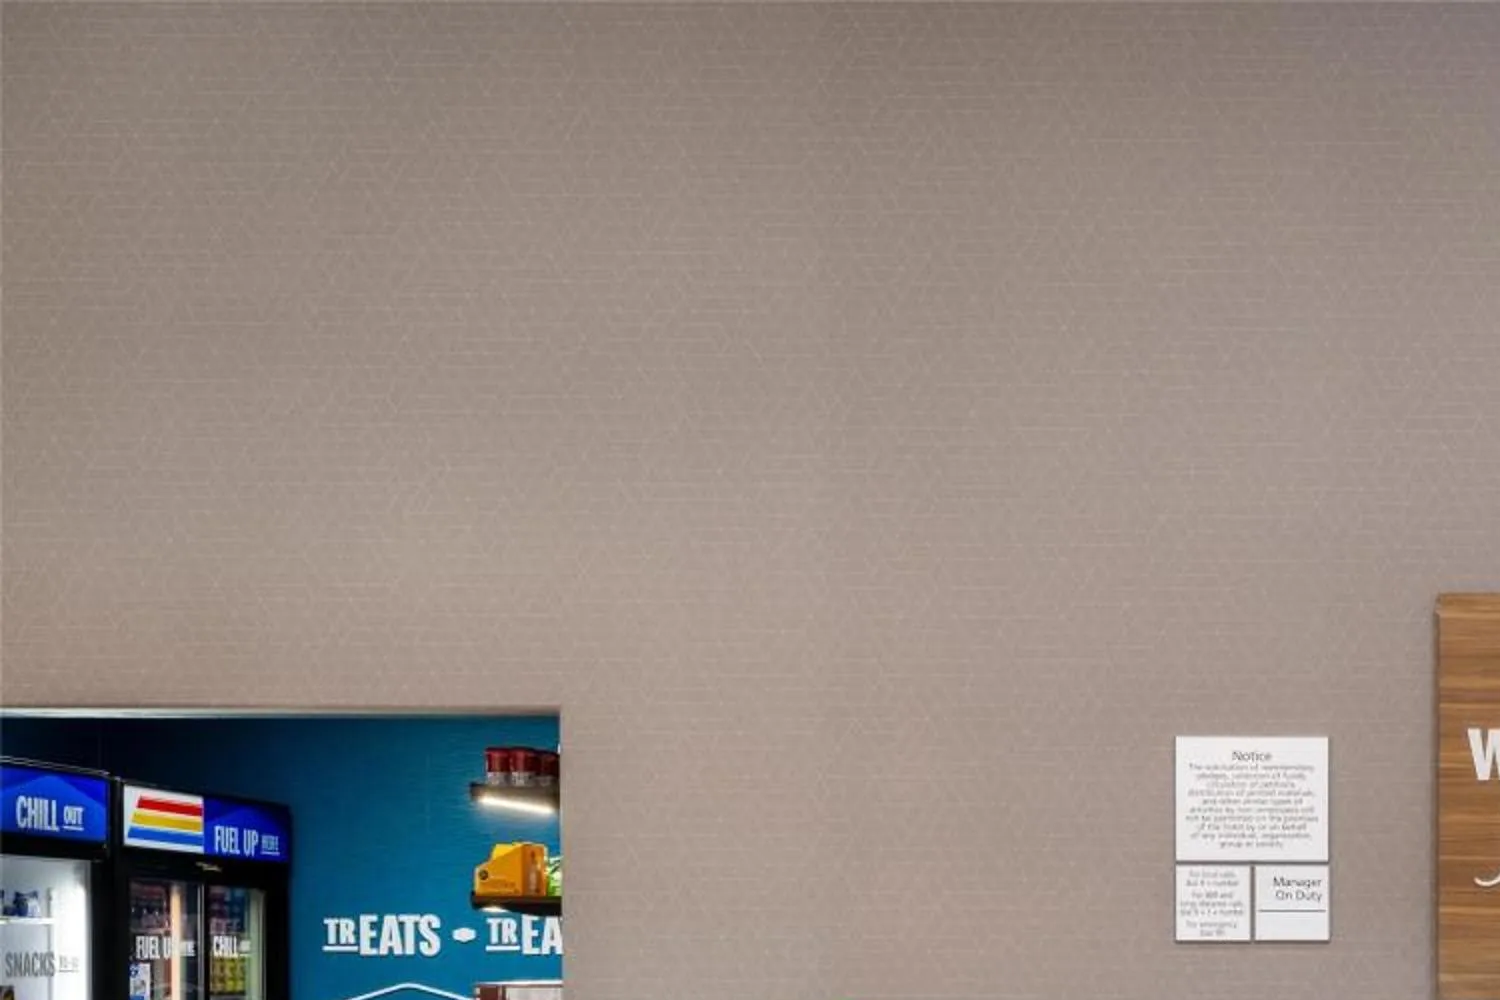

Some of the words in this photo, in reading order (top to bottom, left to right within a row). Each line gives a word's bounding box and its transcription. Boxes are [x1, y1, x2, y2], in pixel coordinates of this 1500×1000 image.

[1232, 751, 1273, 762] Notice
[16, 795, 59, 832] CHILL
[63, 805, 84, 825] OUT
[214, 825, 240, 854] FUEL
[243, 828, 259, 857] UP
[1273, 876, 1321, 888] Manager
[1276, 889, 1293, 901] On
[1295, 889, 1322, 903] Duty
[135, 935, 160, 959] FUEL
[213, 935, 239, 958] CHILL
[322, 914, 441, 957] TREATS
[5, 951, 55, 977] SNACKS
